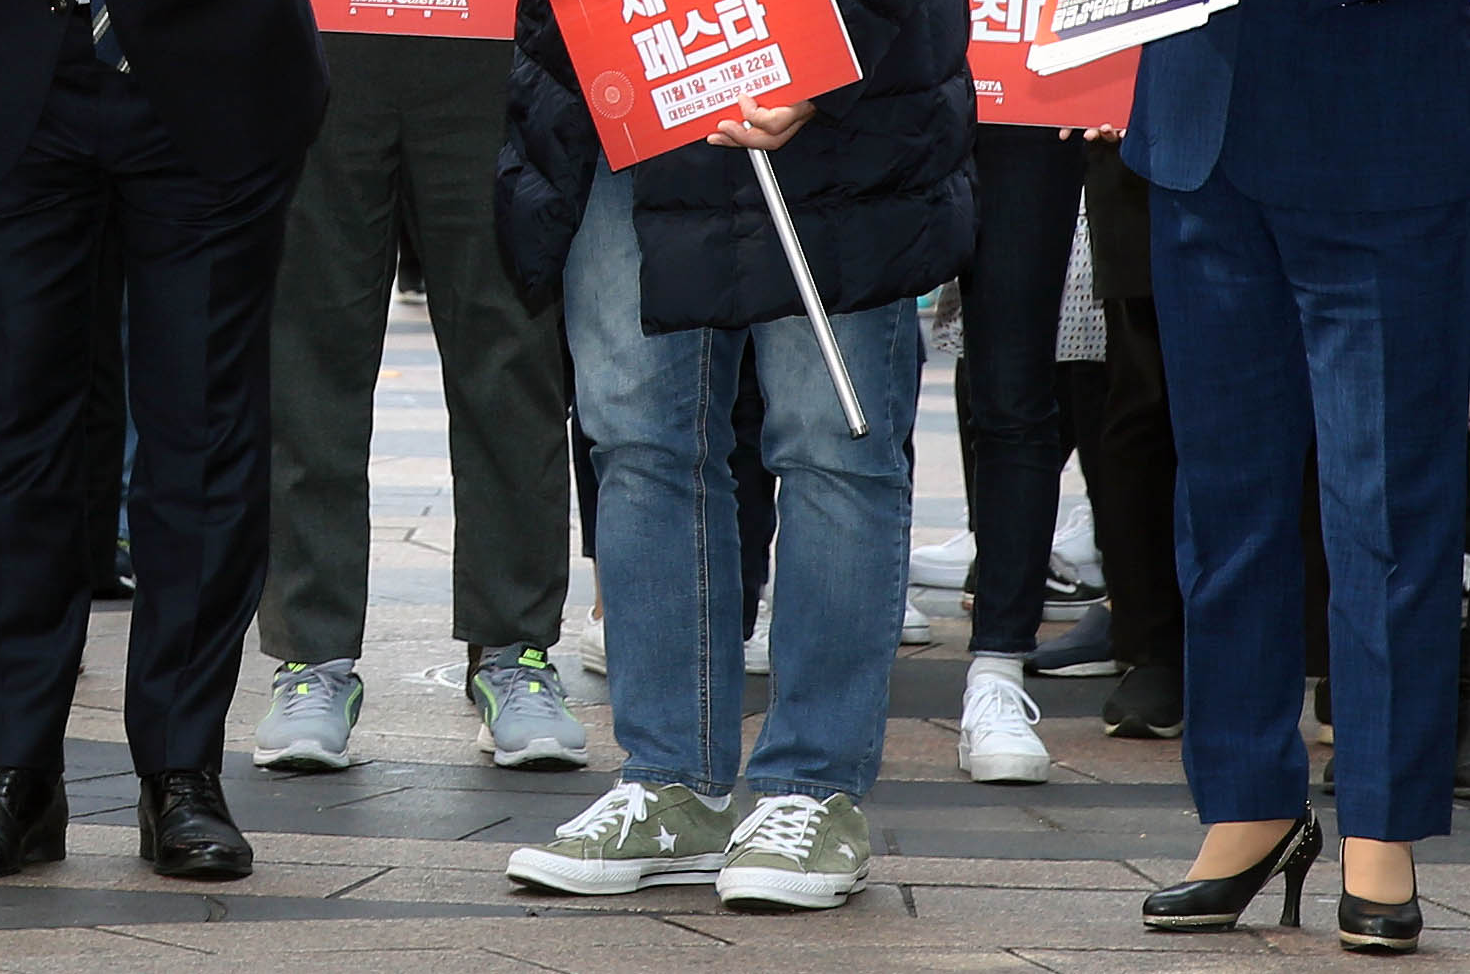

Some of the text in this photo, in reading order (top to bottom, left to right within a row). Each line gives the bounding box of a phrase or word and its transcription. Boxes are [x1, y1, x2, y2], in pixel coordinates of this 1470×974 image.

[660, 84, 686, 106] 11월
[686, 76, 707, 95] 1일
[719, 63, 745, 84] 11월
[745, 51, 776, 74] 22일
[668, 98, 706, 122] 대한민국
[744, 70, 782, 94] 쇼핑행사
